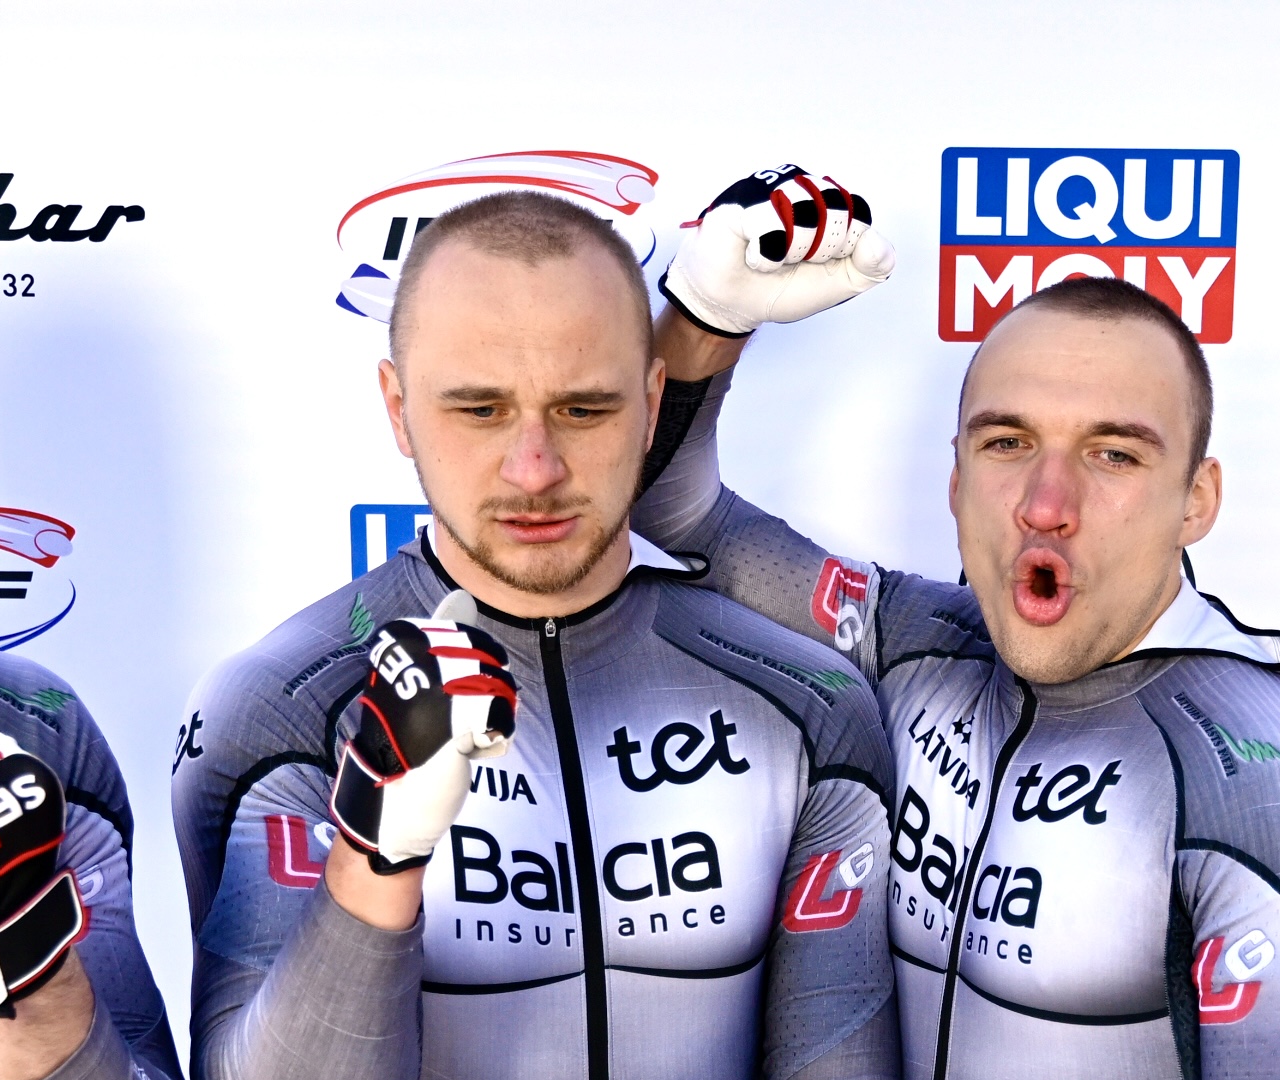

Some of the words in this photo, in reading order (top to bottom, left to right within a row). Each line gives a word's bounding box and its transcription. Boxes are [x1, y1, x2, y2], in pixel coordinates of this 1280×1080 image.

[754, 164, 796, 185] SE
[956, 156, 1224, 244] LIQUI
[470, 765, 537, 805] VIJA
[606, 709, 751, 793] tet
[908, 708, 981, 810] LATVIJA
[1012, 759, 1122, 825] tet
[450, 824, 722, 914] Balcia
[781, 842, 875, 933] LG
[455, 904, 726, 947] insurance
[891, 880, 1033, 965] nsurance
